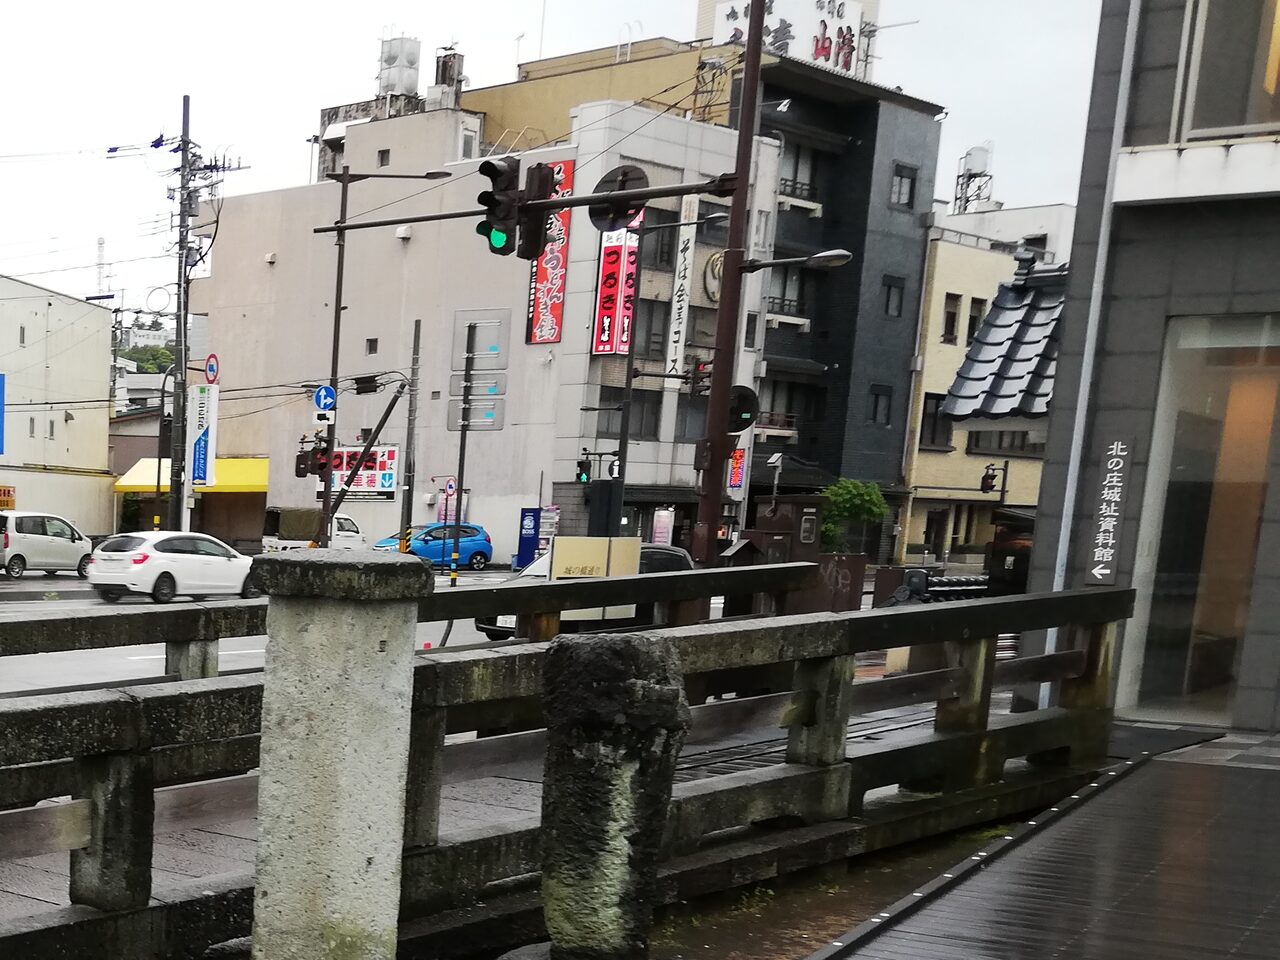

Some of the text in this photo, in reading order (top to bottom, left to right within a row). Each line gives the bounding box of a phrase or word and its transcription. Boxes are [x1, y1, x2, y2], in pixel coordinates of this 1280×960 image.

[1094, 441, 1128, 561] 北の庄城址資料館
